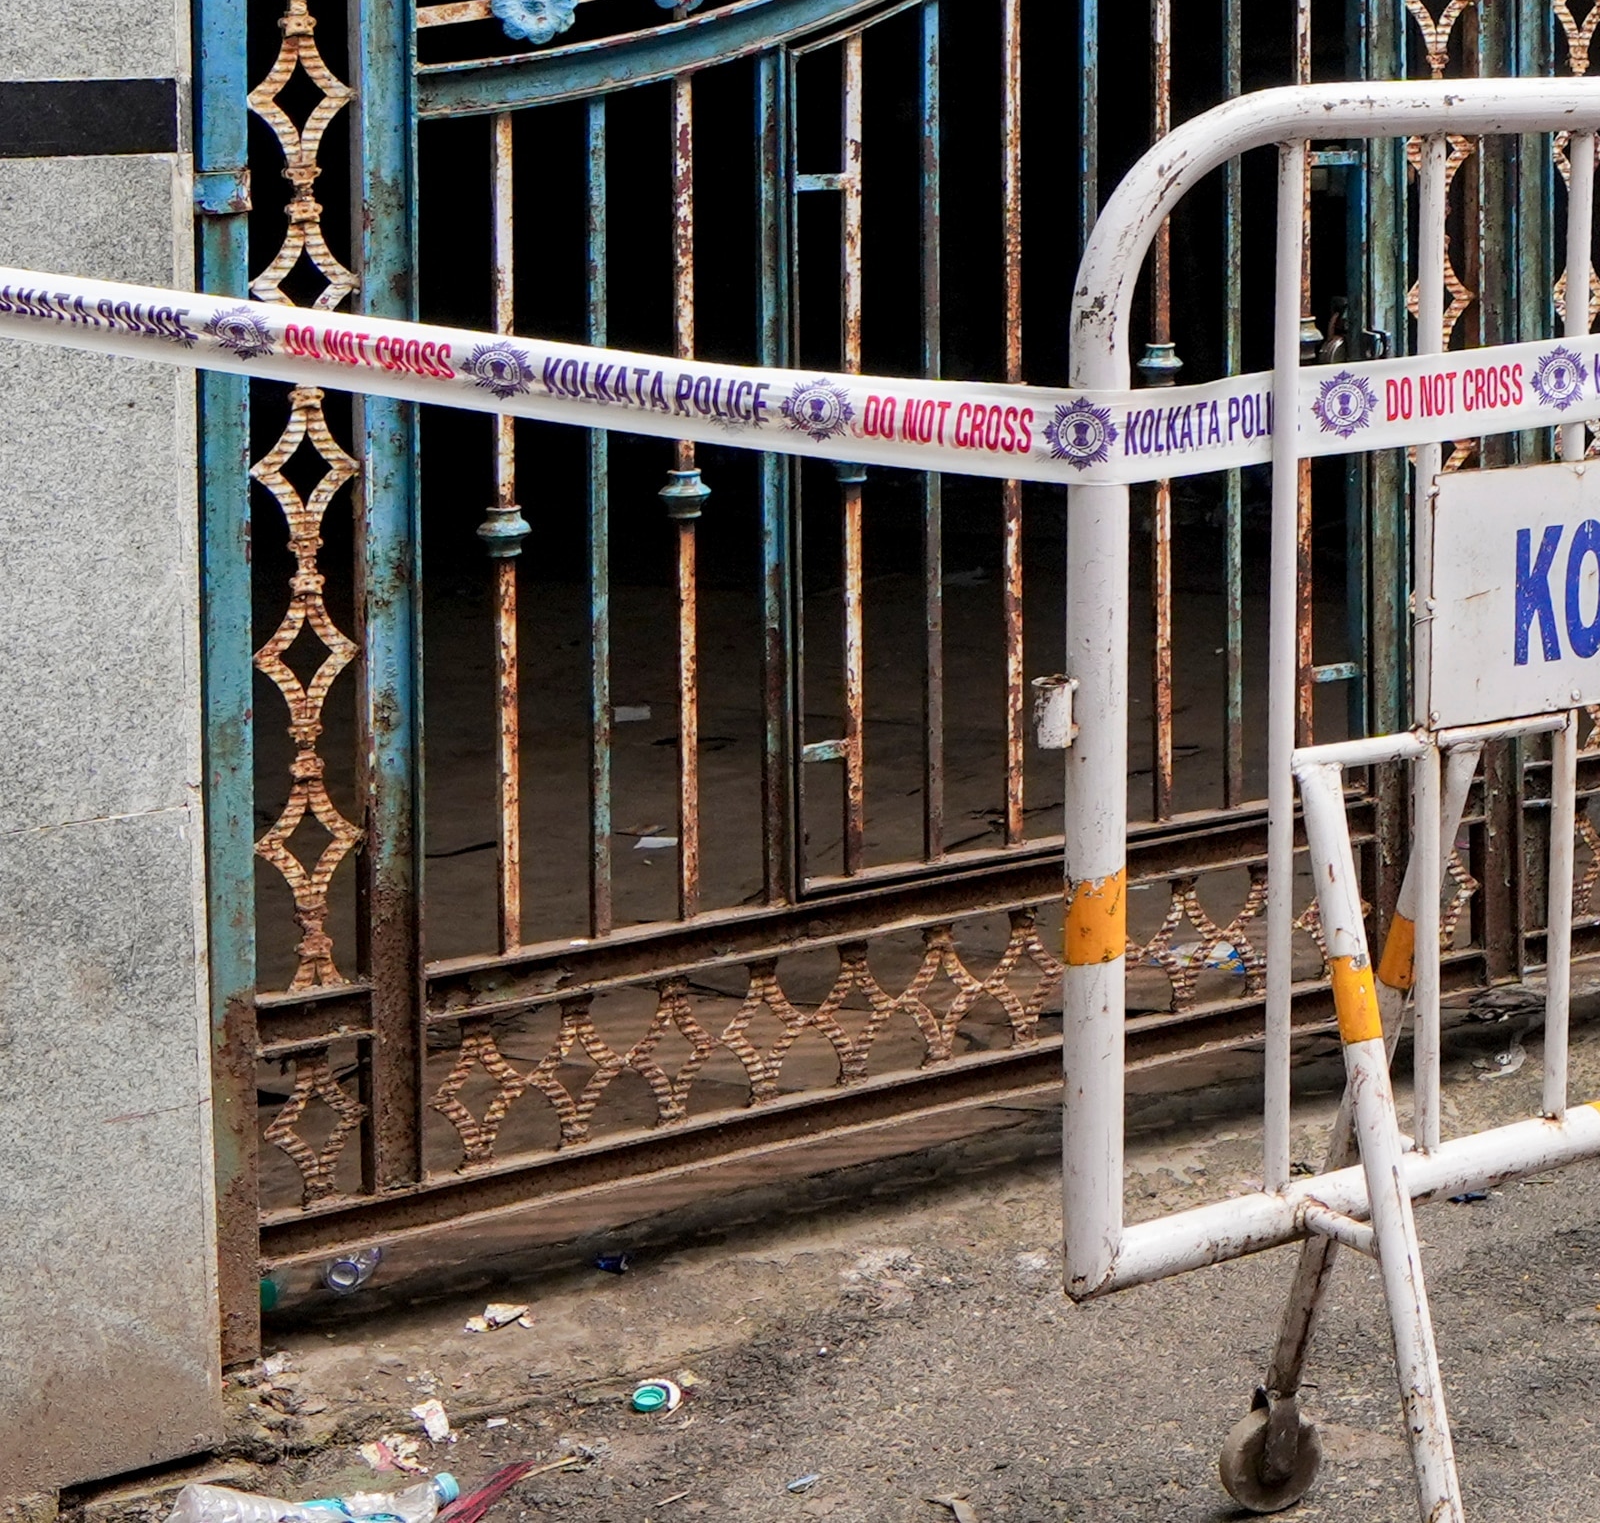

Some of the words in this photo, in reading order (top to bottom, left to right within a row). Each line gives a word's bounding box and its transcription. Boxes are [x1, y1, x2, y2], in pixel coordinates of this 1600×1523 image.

[97, 298, 199, 340] POLICE
[284, 322, 316, 359] DO
[323, 328, 371, 368] NOT
[375, 334, 456, 379] CROSS
[542, 356, 670, 414] KOLKATA
[674, 373, 771, 423] POLICE
[1385, 378, 1412, 422] DO
[1419, 372, 1457, 417] NOT
[1462, 363, 1524, 412] CROSS
[863, 394, 897, 439] DO
[902, 398, 951, 447] NOT
[959, 402, 1035, 454] CROSS
[1124, 399, 1220, 456] KOLKATA
[1228, 391, 1274, 441] POLI
